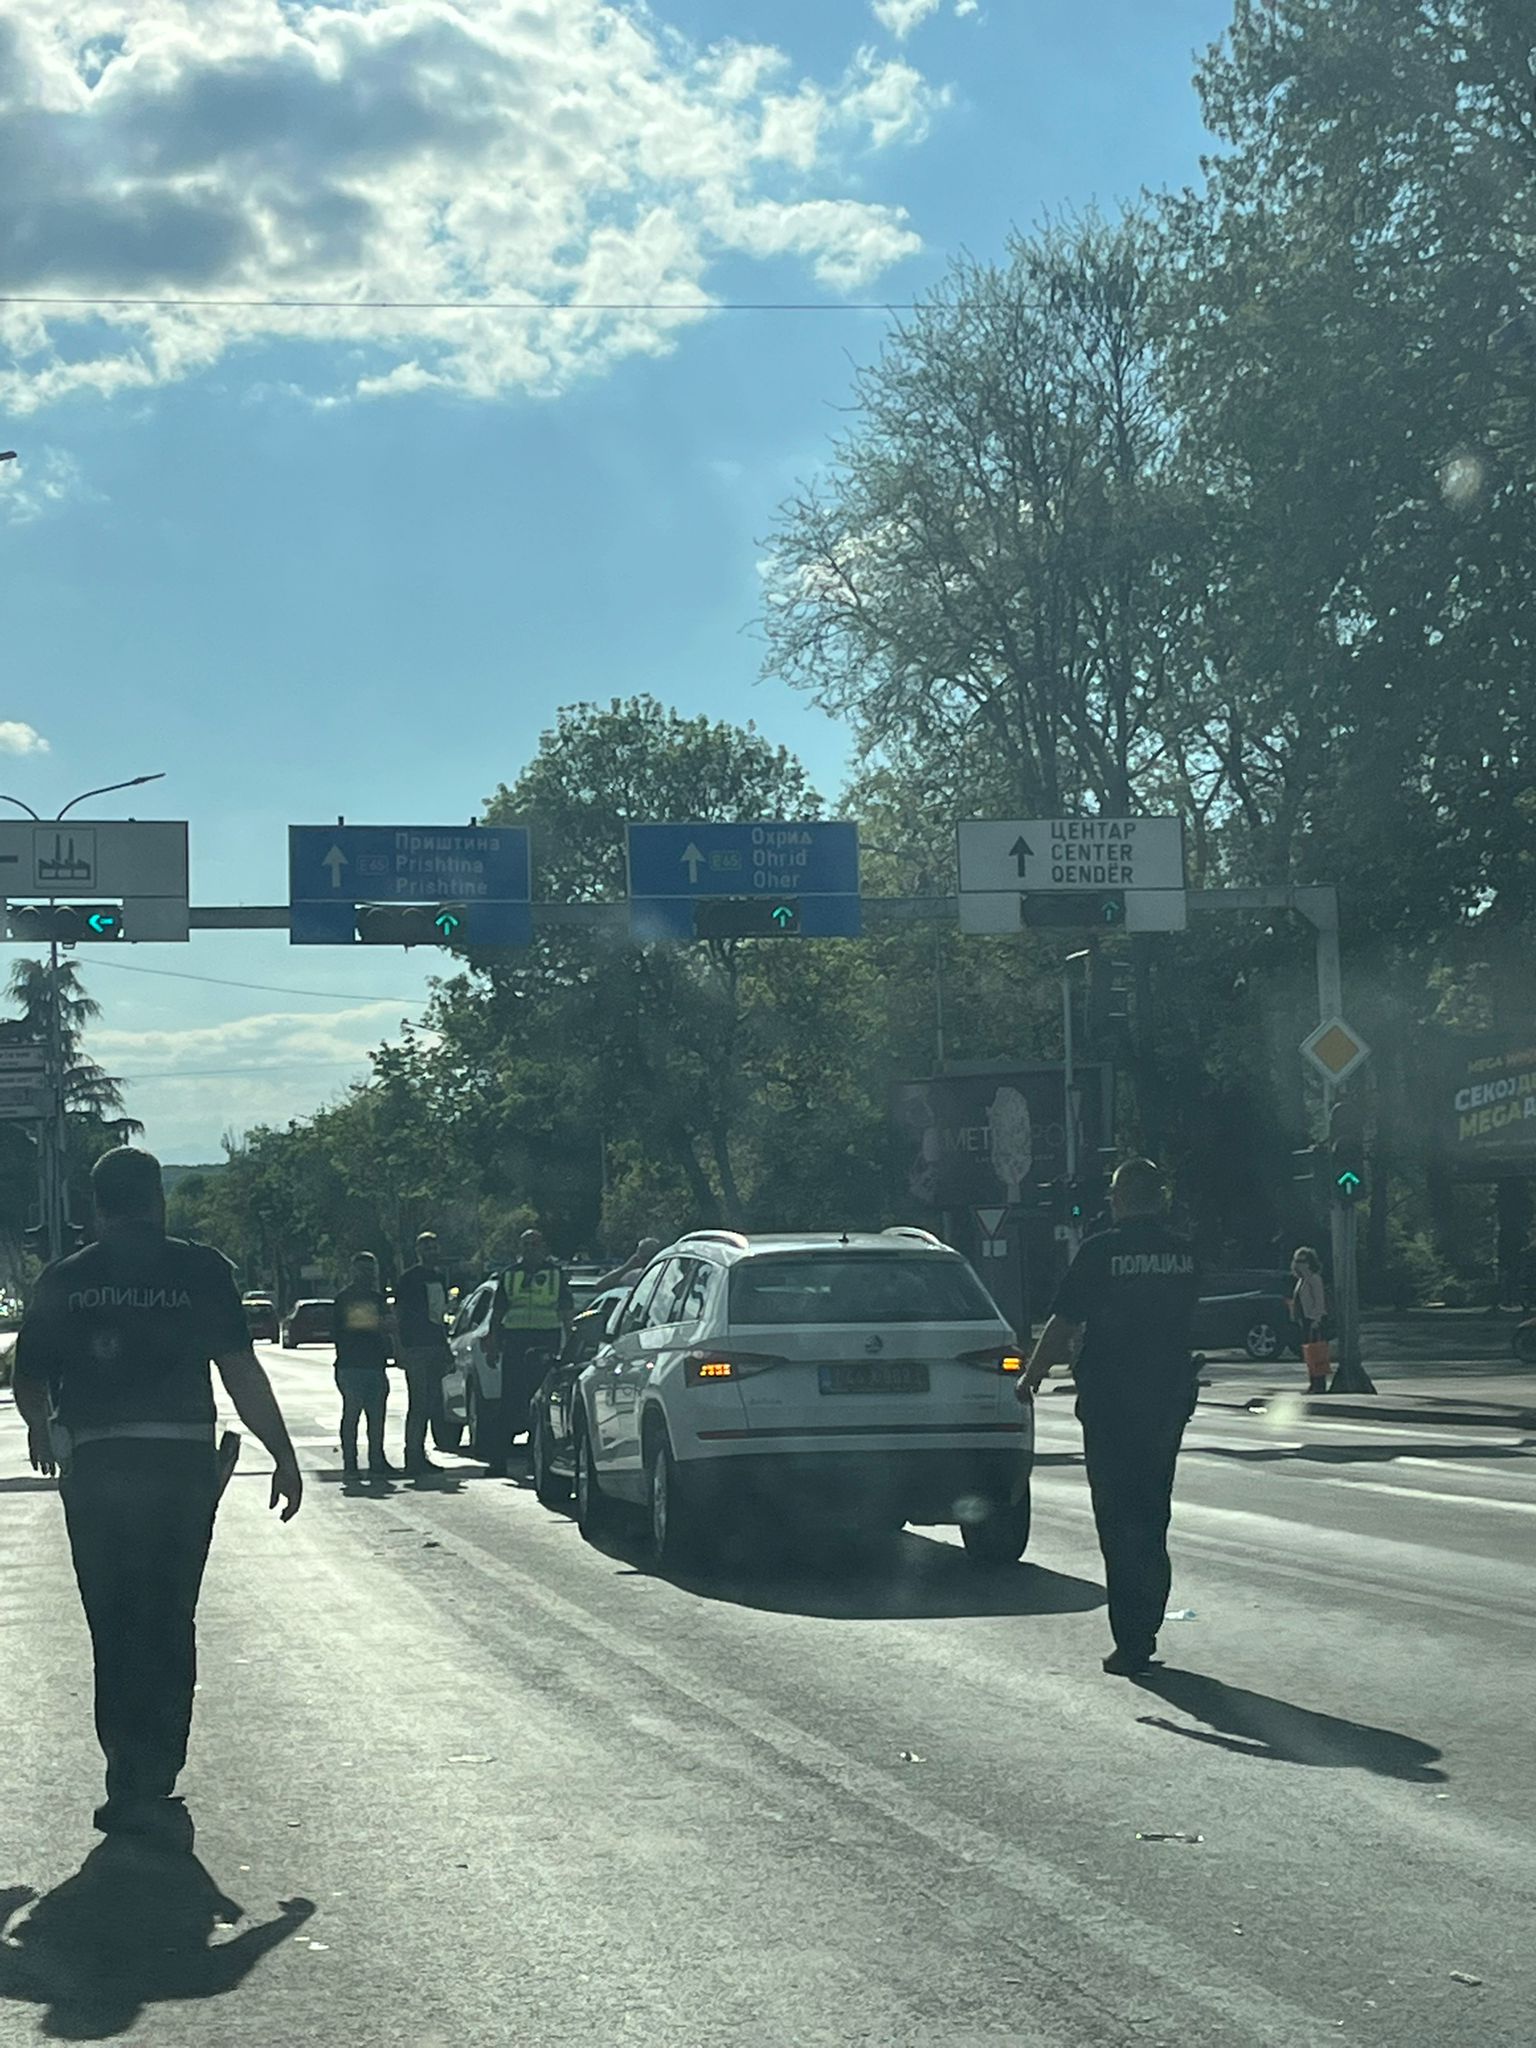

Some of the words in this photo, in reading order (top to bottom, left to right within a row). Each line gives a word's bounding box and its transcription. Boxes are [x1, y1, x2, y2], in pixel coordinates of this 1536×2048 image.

[752, 826, 813, 849] Охрид
[1051, 821, 1136, 841] ЦЕНТАР
[395, 831, 500, 854] Приштина
[1051, 843, 1133, 861] CENTER
[396, 854, 485, 874] Prishtina
[753, 848, 808, 867] Ohrid
[753, 870, 801, 889] Oher
[1458, 1101, 1522, 1141] MEGA
[68, 1286, 193, 1312] ПОЛИЦИЈА
